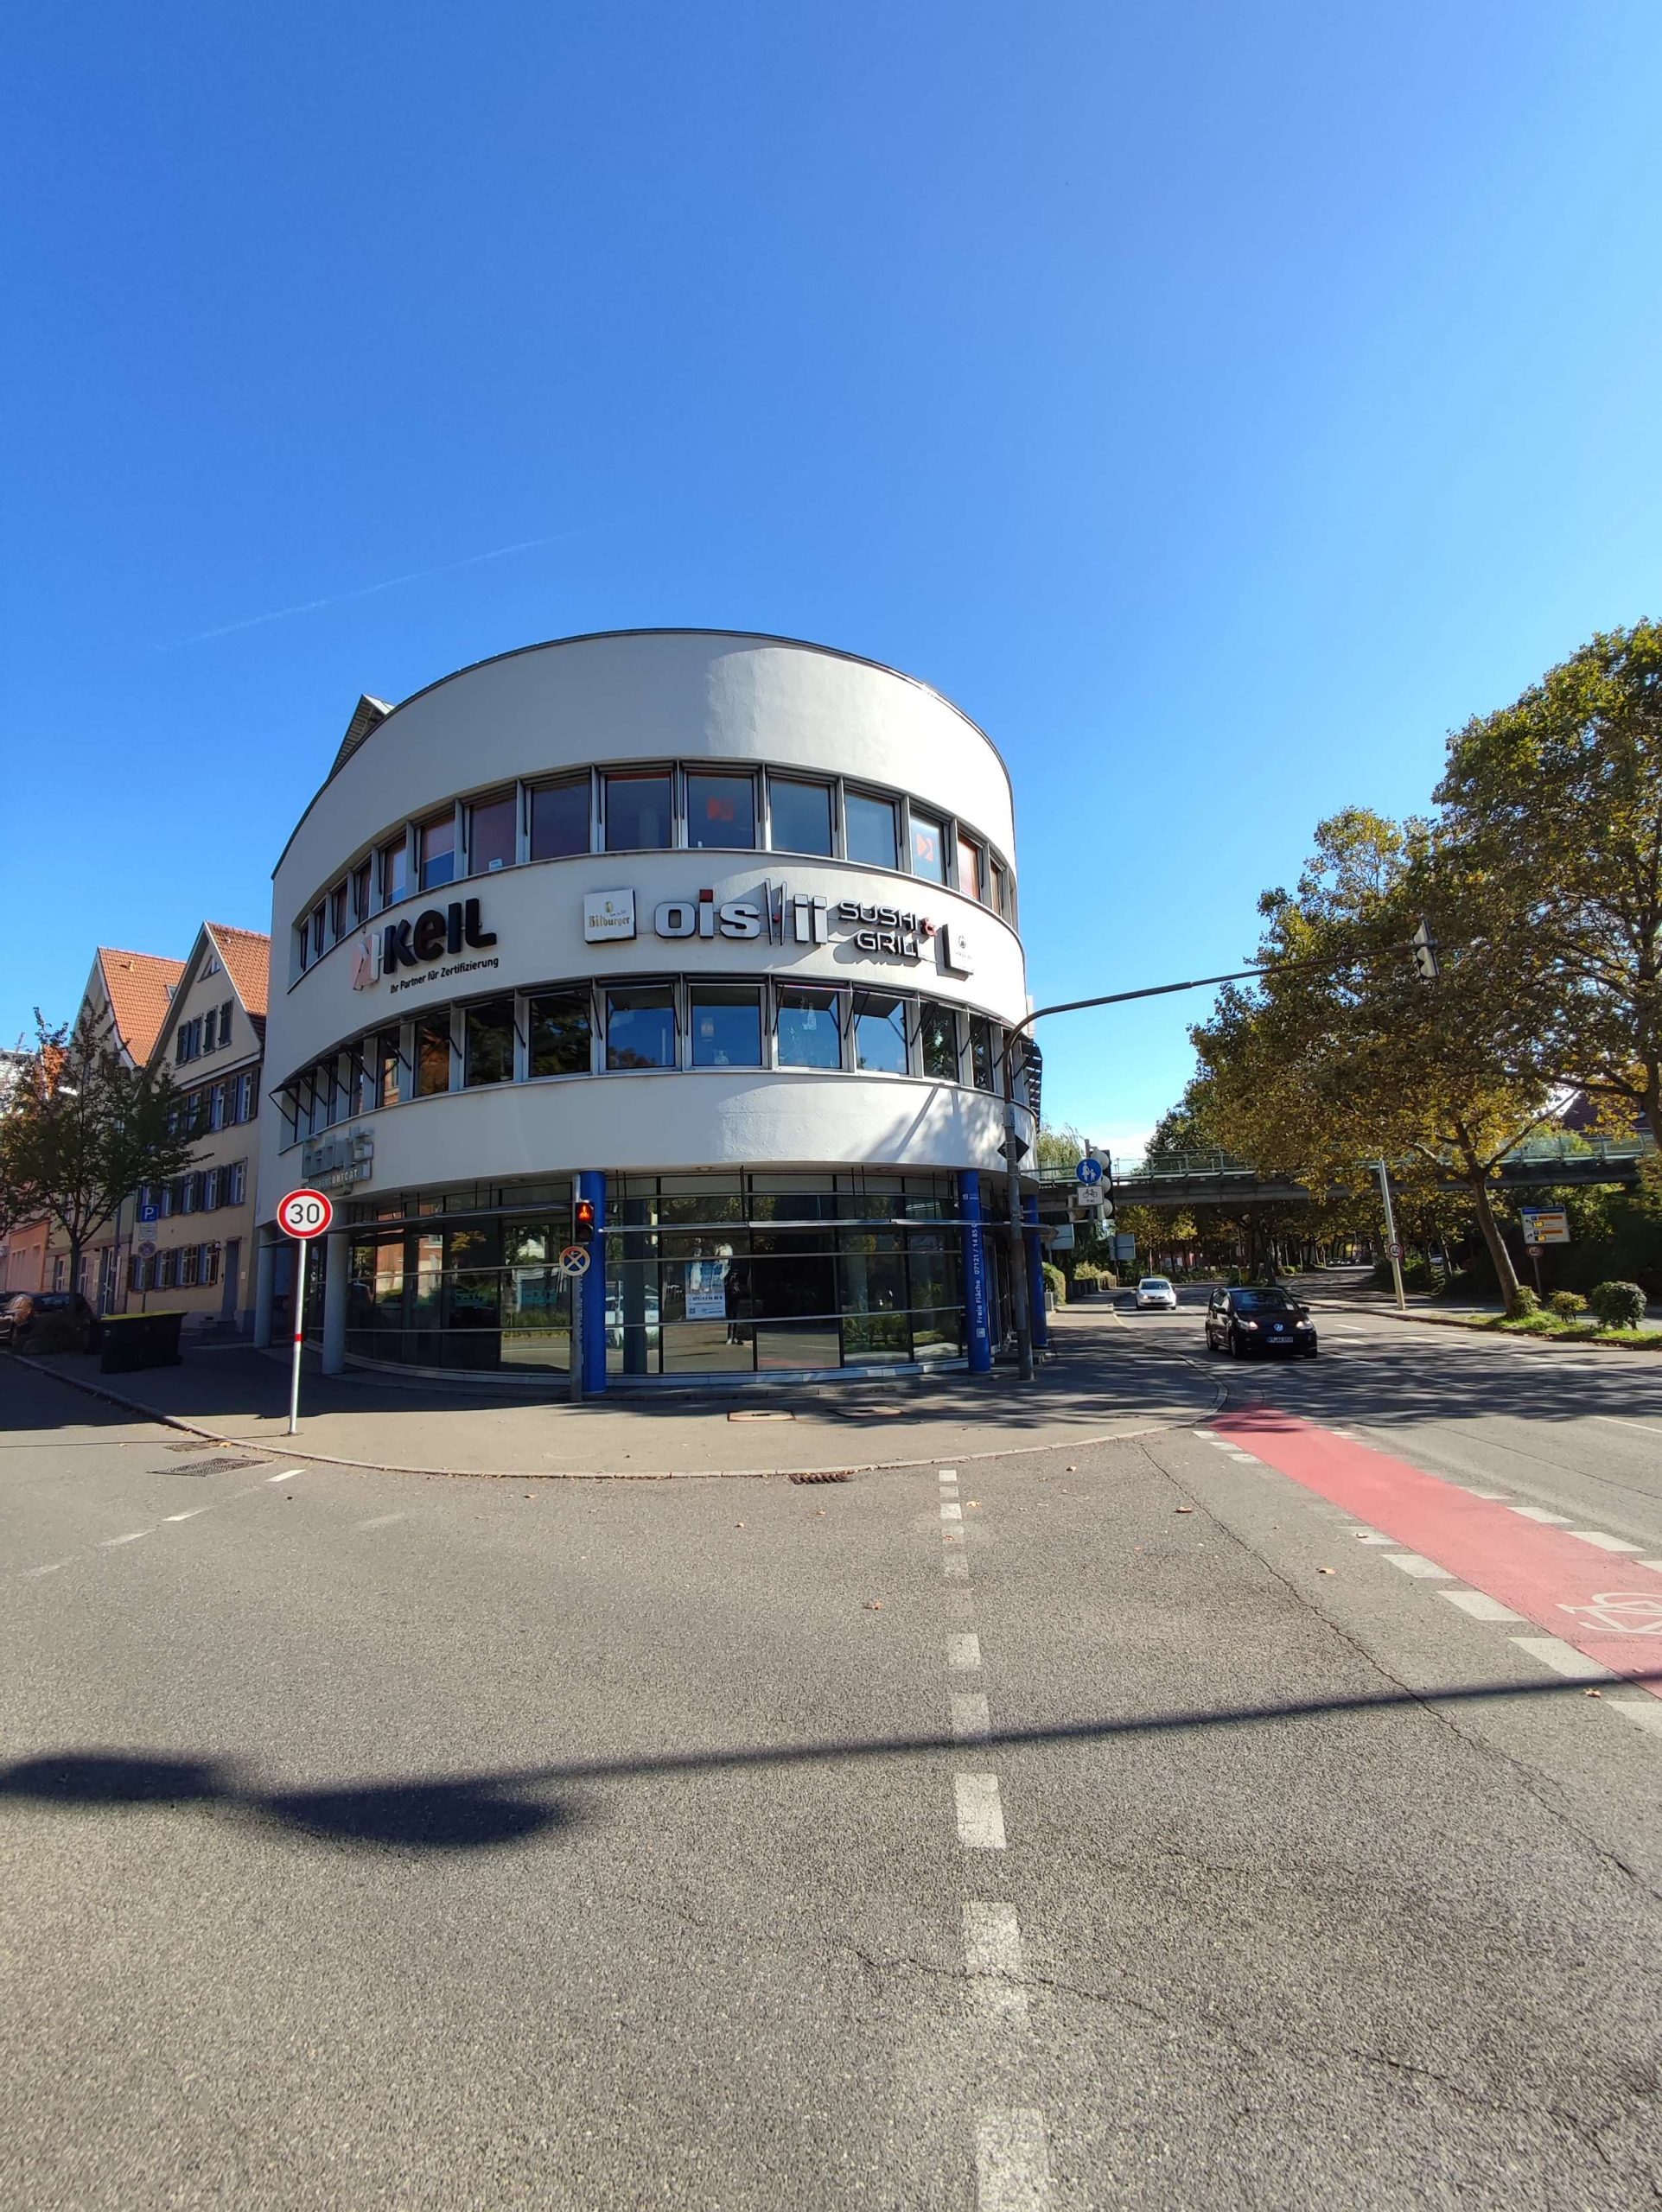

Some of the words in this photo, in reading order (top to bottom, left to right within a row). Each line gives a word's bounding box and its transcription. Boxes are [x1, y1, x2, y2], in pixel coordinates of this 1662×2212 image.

[838, 899, 918, 931] SUSHI
[855, 929, 930, 961] GRILL
[390, 982, 399, 994] Ihr
[400, 973, 426, 990] Partner
[428, 969, 440, 982] für
[441, 957, 500, 977] Zertifizierung
[144, 1206, 155, 1220] P
[290, 1203, 320, 1224] 30
